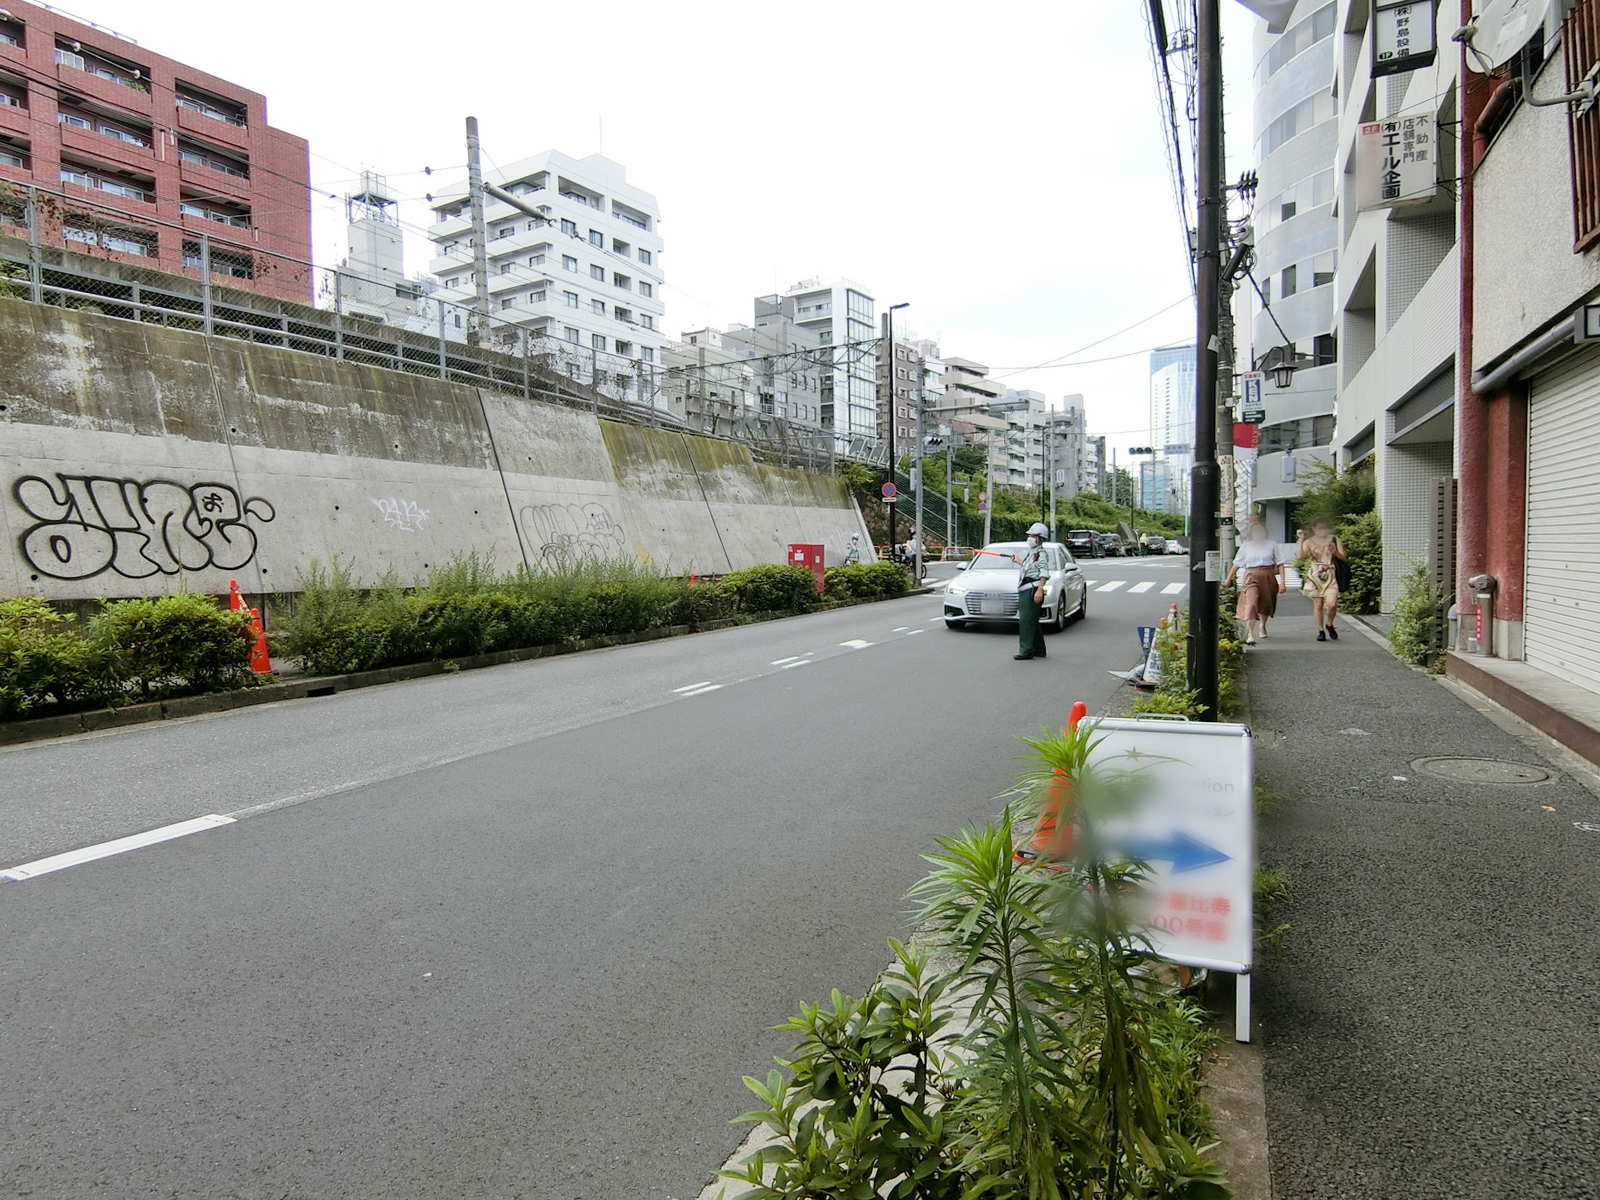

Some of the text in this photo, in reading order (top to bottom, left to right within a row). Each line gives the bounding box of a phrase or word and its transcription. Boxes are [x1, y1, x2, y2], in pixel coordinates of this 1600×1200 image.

[1364, 125, 1379, 134] 2F
[1403, 118, 1415, 164] 店舗専門
[1416, 115, 1429, 162] 不動産
[1381, 121, 1401, 199] (有)エール企画
